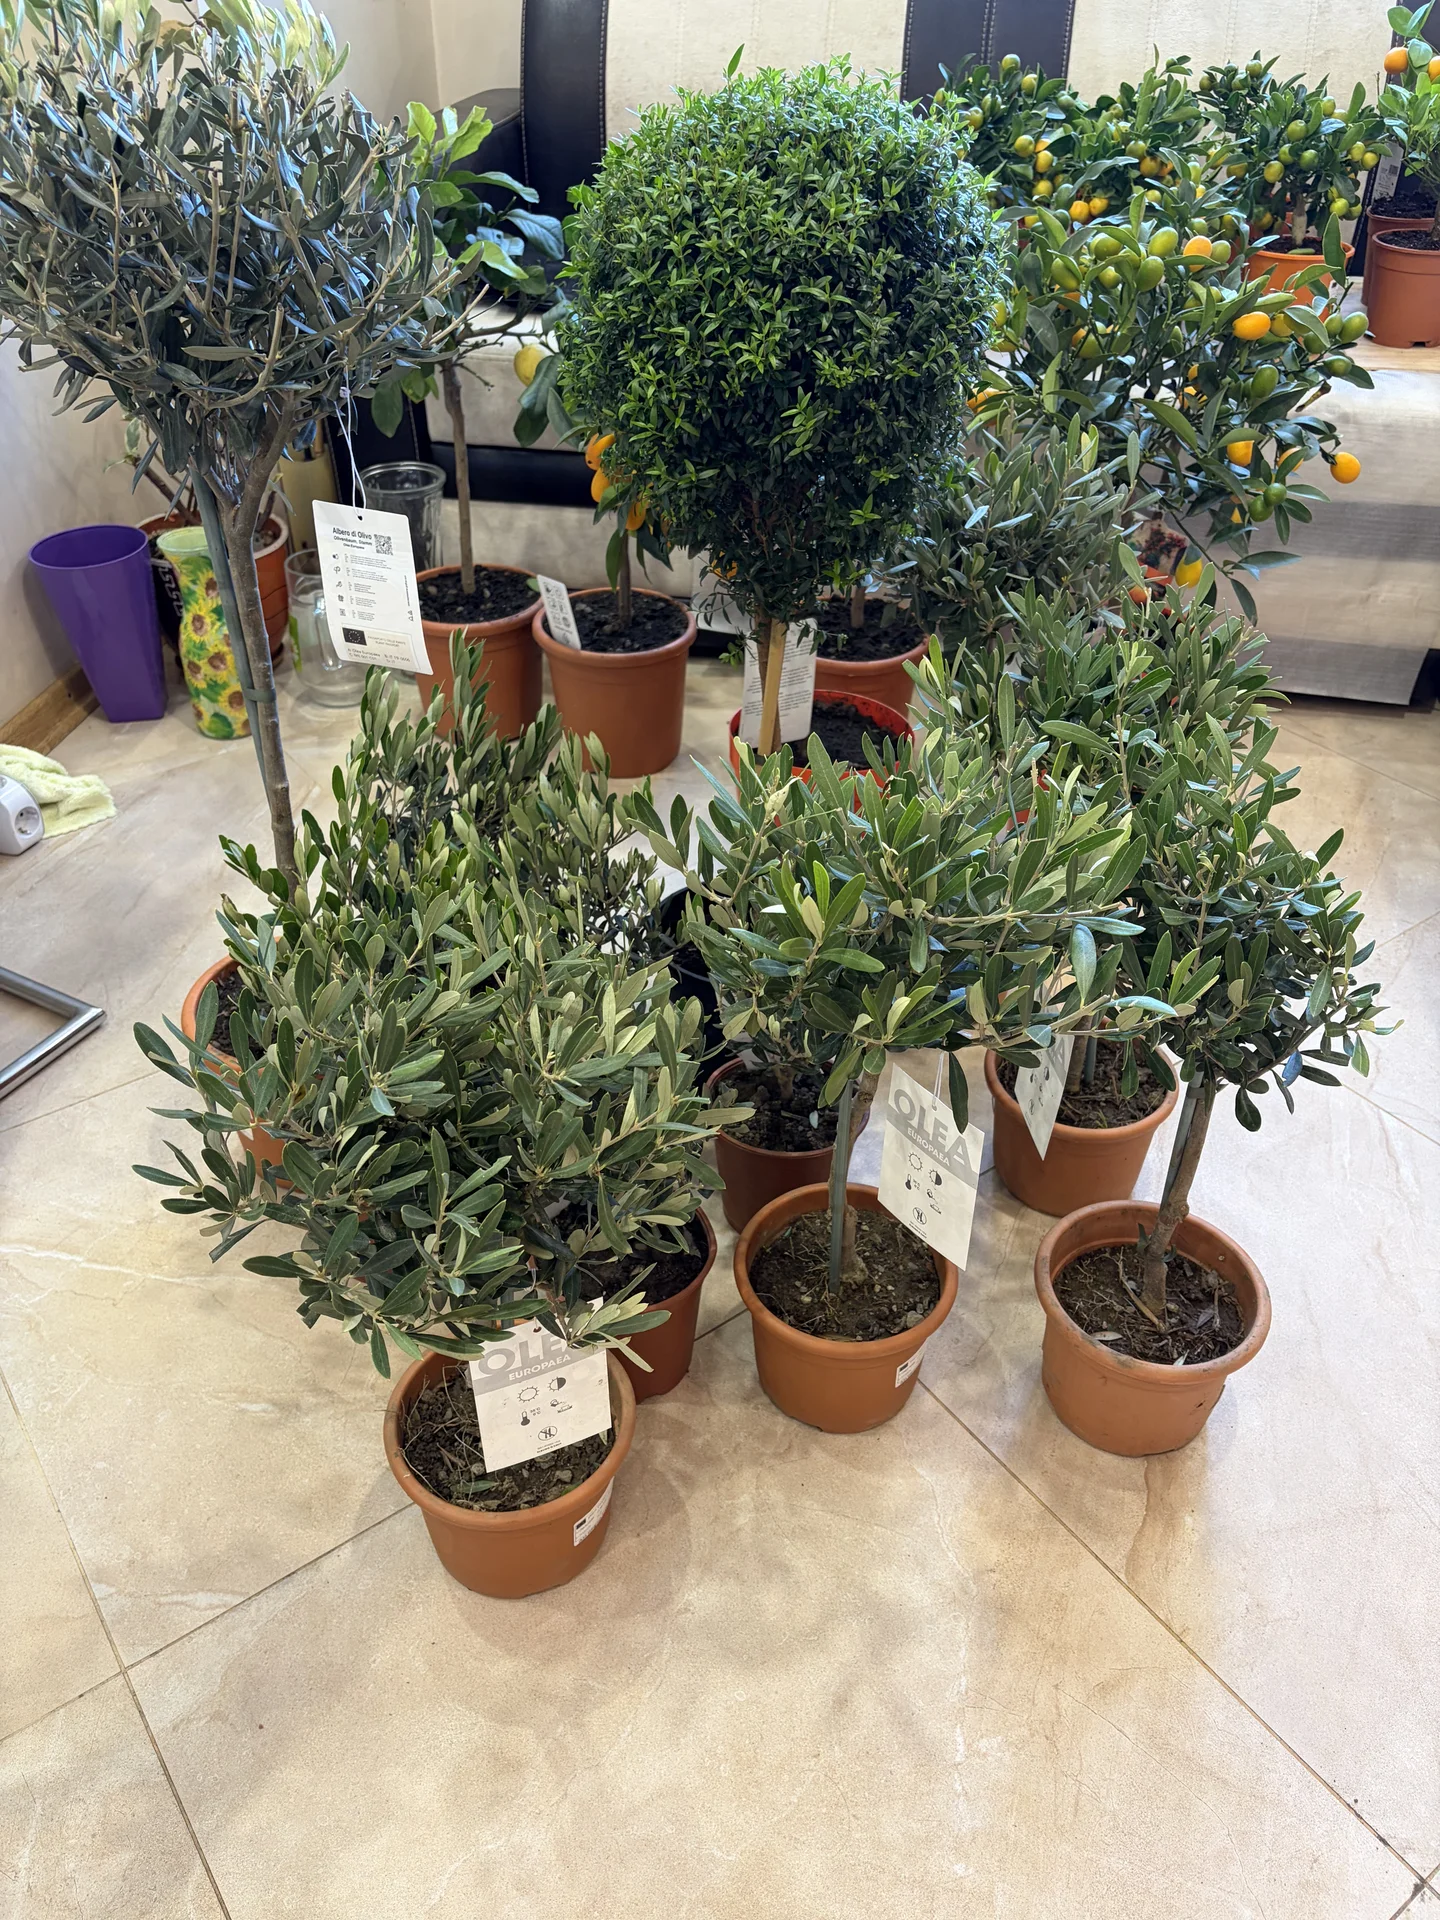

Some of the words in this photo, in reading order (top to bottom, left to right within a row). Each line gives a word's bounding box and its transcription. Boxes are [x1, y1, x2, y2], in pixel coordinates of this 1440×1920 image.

[332, 527, 350, 536] Albero
[357, 531, 372, 540] Olivo
[894, 1088, 973, 1170] OLEA
[907, 1127, 950, 1166] EUROPAEA
[478, 1333, 568, 1377] OLE
[508, 1354, 571, 1380] EUROPAEA
